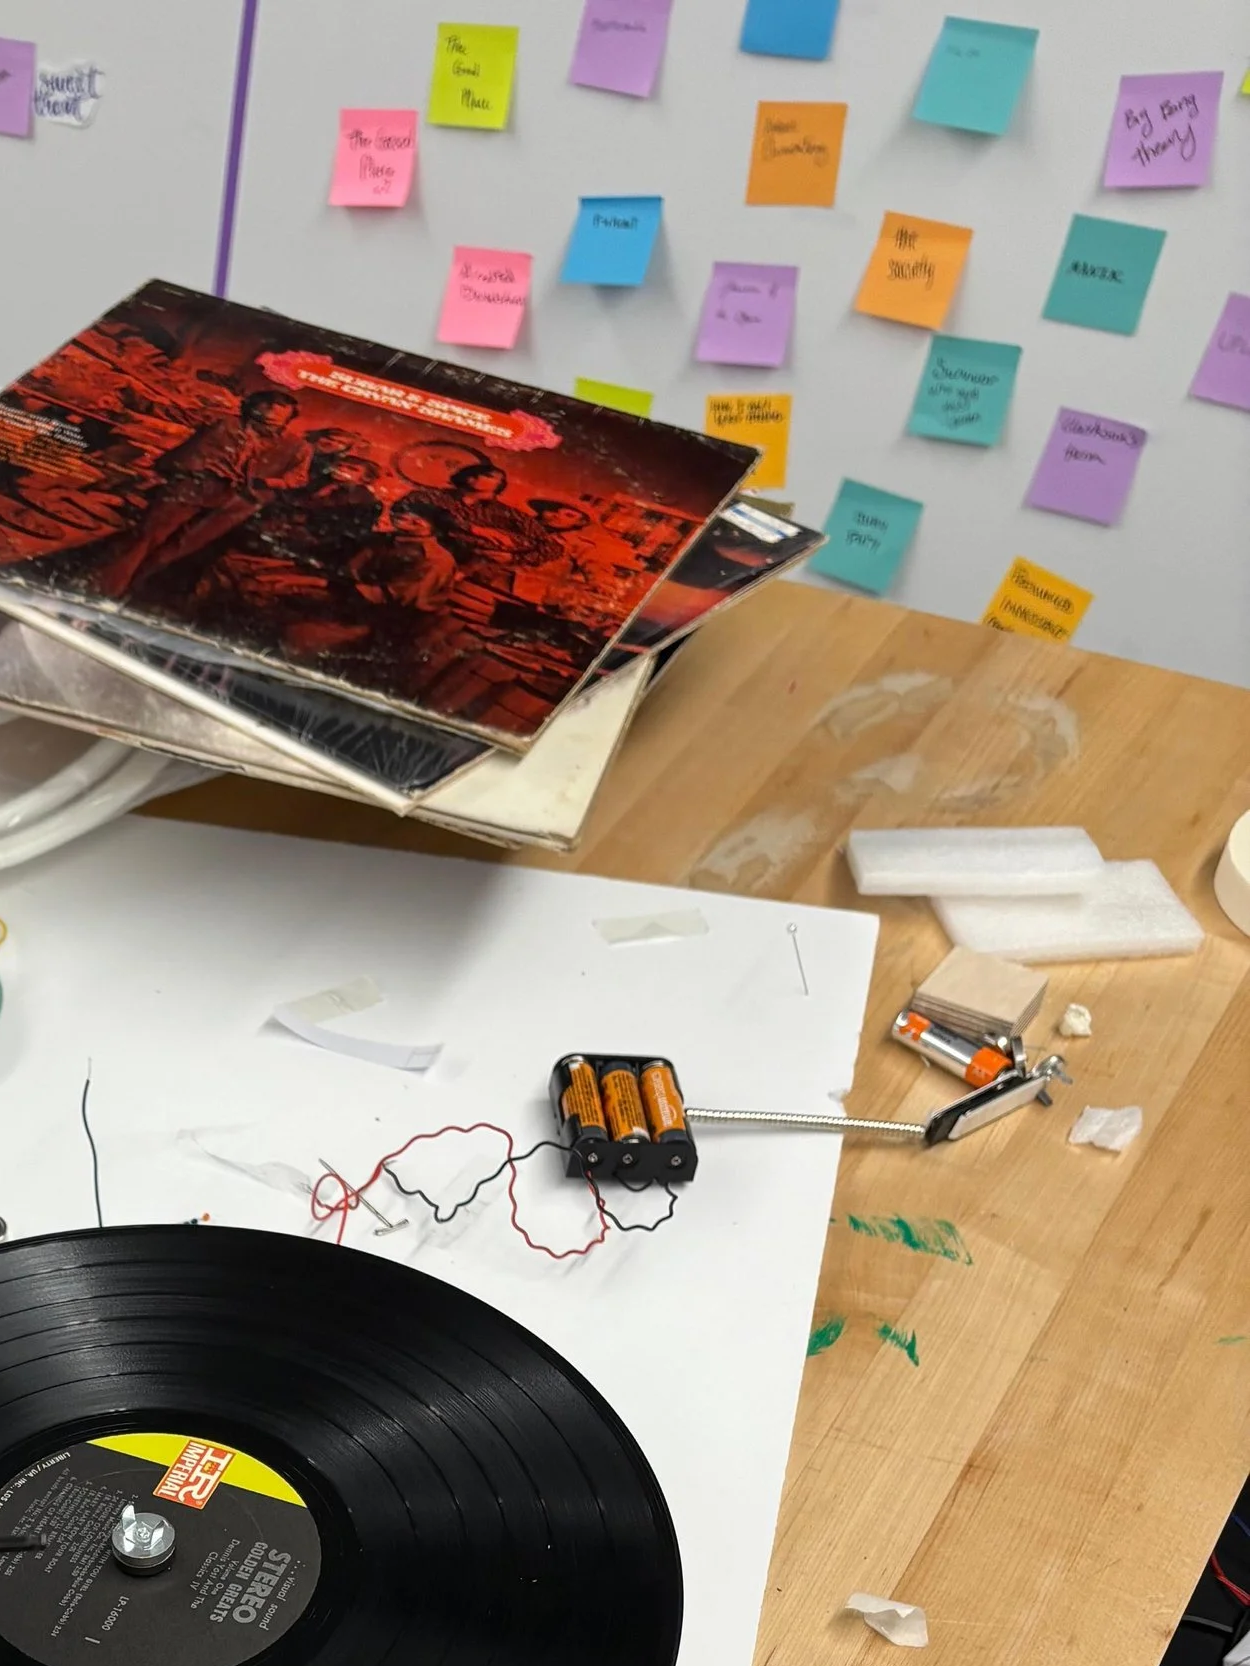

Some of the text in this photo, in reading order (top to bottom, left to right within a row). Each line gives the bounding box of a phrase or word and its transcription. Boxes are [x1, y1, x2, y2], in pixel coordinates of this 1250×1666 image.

[157, 1439, 206, 1501] IMPERIAL
[0, 1489, 14, 1503] LOS
[88, 1563, 102, 1578] YOU
[189, 1549, 218, 1590] Classics IV
[189, 1537, 240, 1610] Dennis Yost And The
[208, 1539, 268, 1625] GOLDEN GREATS
[210, 1558, 239, 1595] Volume One
[229, 1545, 292, 1628] STEREO
[100, 1594, 130, 1632] LP-16000
[258, 1602, 278, 1631] sound
